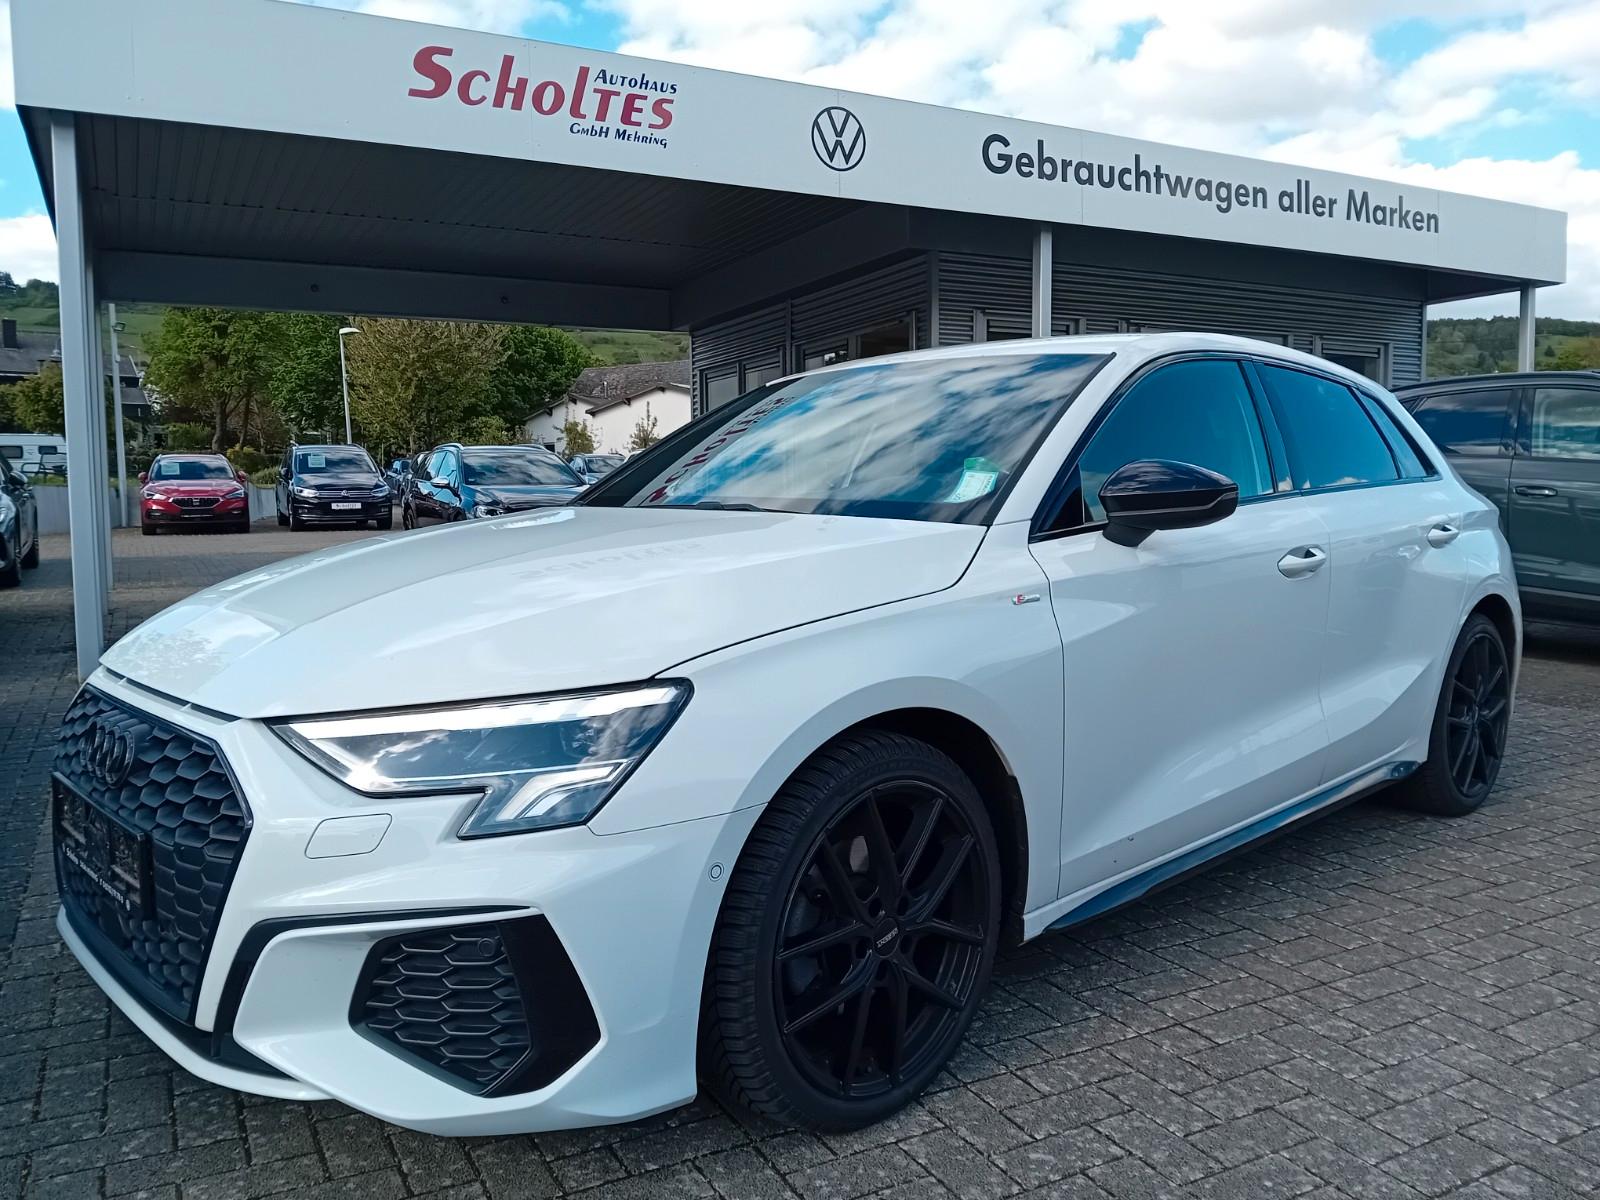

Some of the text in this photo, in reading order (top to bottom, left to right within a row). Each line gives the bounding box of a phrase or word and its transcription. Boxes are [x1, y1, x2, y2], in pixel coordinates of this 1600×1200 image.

[982, 134, 1439, 233] Gebrauchtwagen aller Marken
